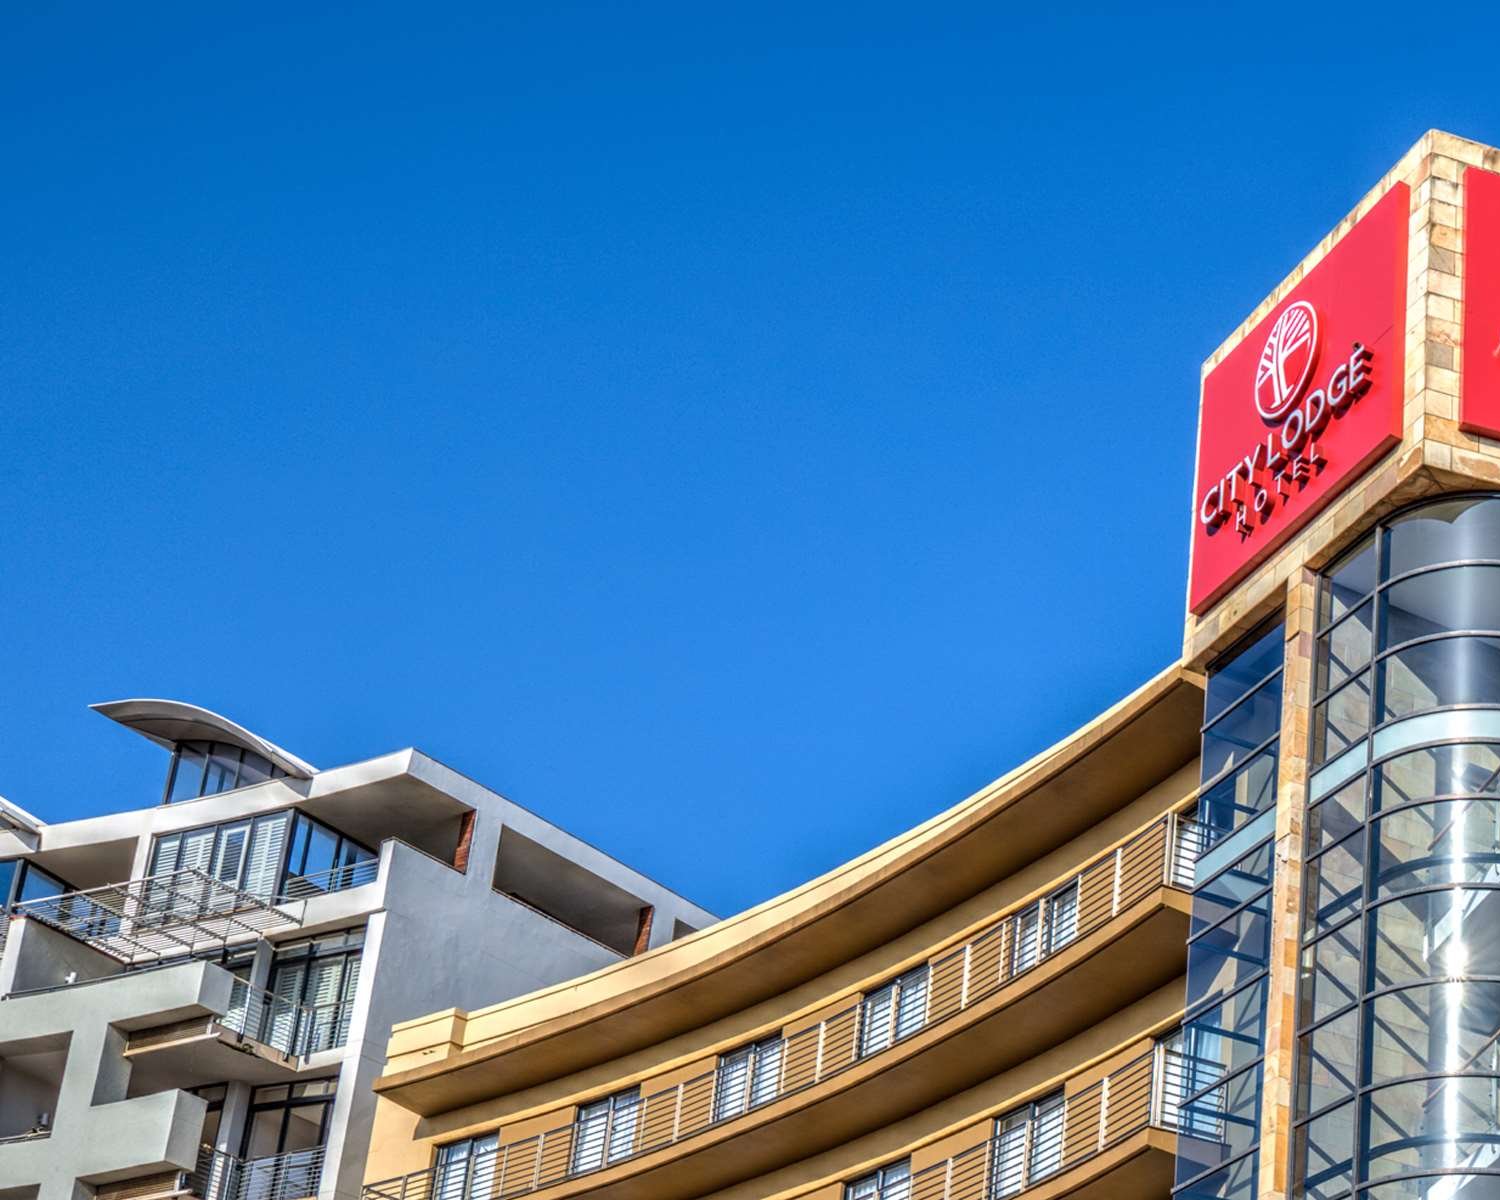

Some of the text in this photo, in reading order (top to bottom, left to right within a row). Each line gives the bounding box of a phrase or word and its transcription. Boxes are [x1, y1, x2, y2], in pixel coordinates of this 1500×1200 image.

[1200, 344, 1366, 524] CITY LODGE
[1235, 442, 1319, 531] HOTEL
